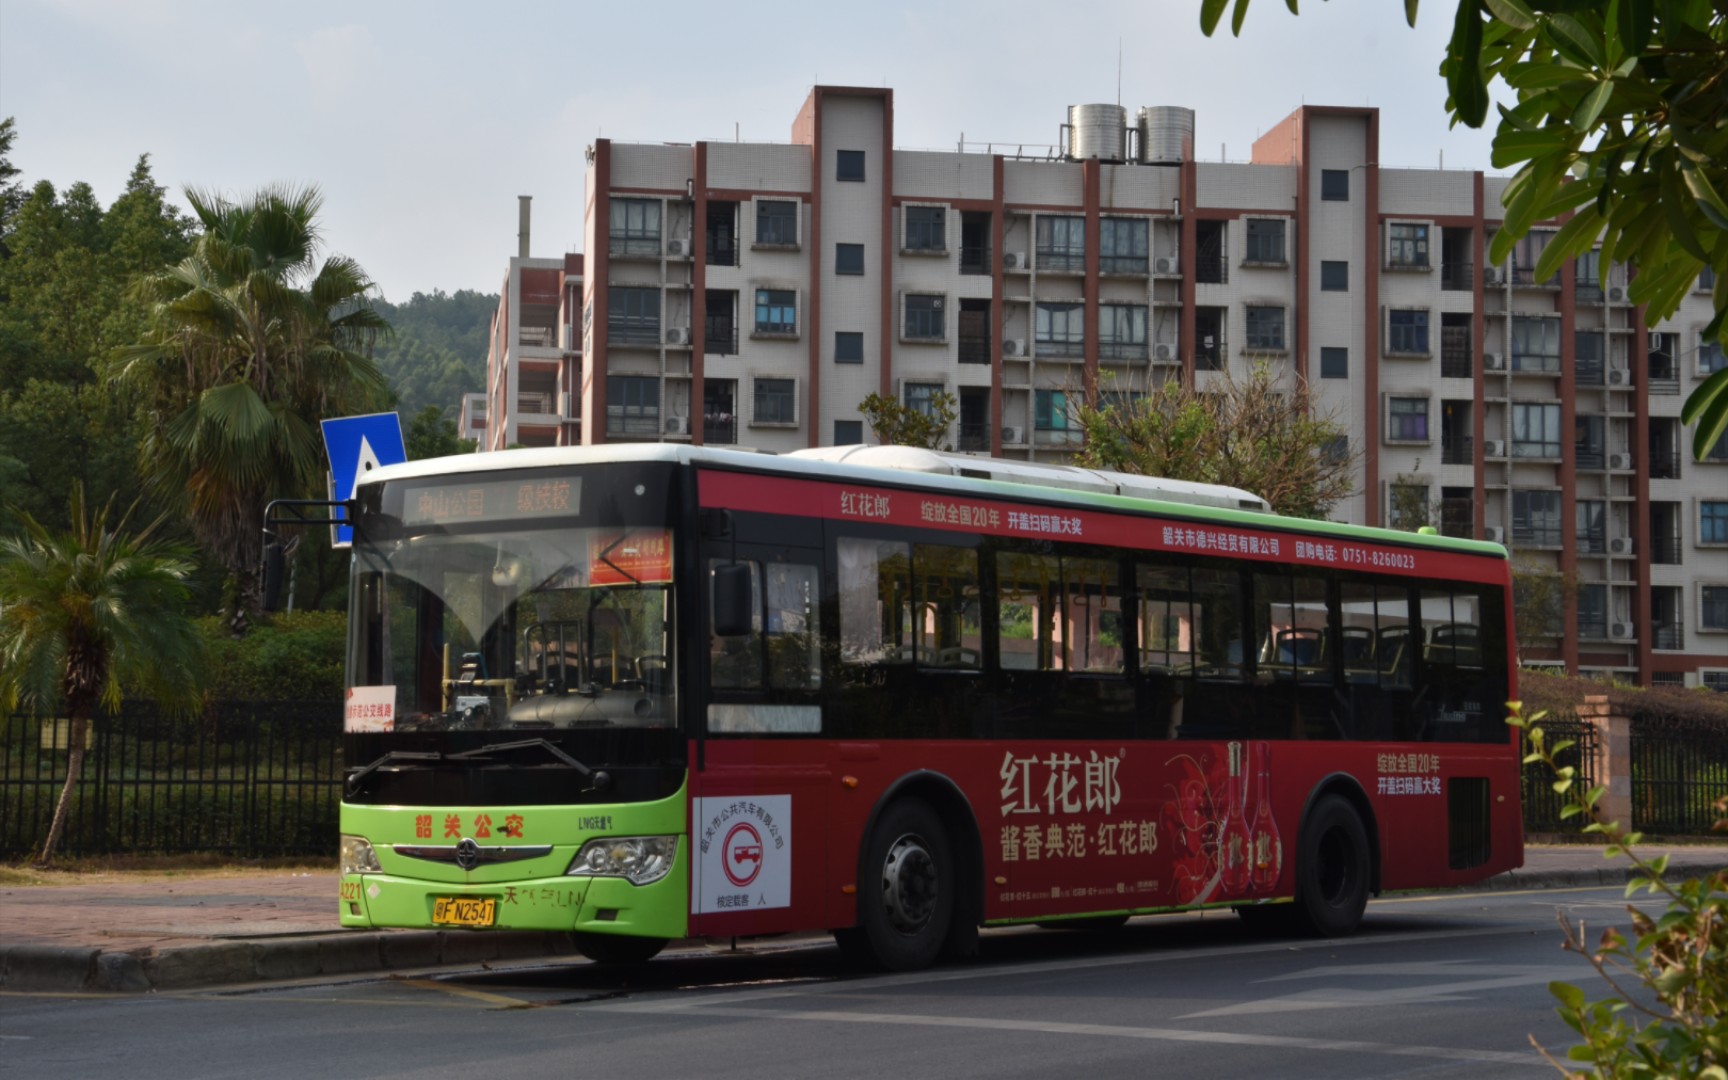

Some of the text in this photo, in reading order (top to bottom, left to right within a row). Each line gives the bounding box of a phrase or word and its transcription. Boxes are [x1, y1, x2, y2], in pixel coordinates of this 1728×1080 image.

[418, 489, 484, 518] 中山公园
[841, 491, 1082, 535] 红花郎 绽放全国20年 开盖扫码赢大奖
[1162, 526, 1280, 556] 韶关市德兴经贸有限公司
[1342, 547, 1415, 569] 0751-8260023
[1377, 752, 1440, 773] 绽放全国20年
[1000, 750, 1121, 817] 红花郎
[1377, 776, 1441, 795] 开盖扫码赢大奖
[416, 813, 523, 838] 韶关公交
[700, 801, 784, 854] 韶关市公共汽车有限公司
[1000, 820, 1158, 861] 酱香典范·红花郎
[716, 893, 766, 909] 核定载客 人
